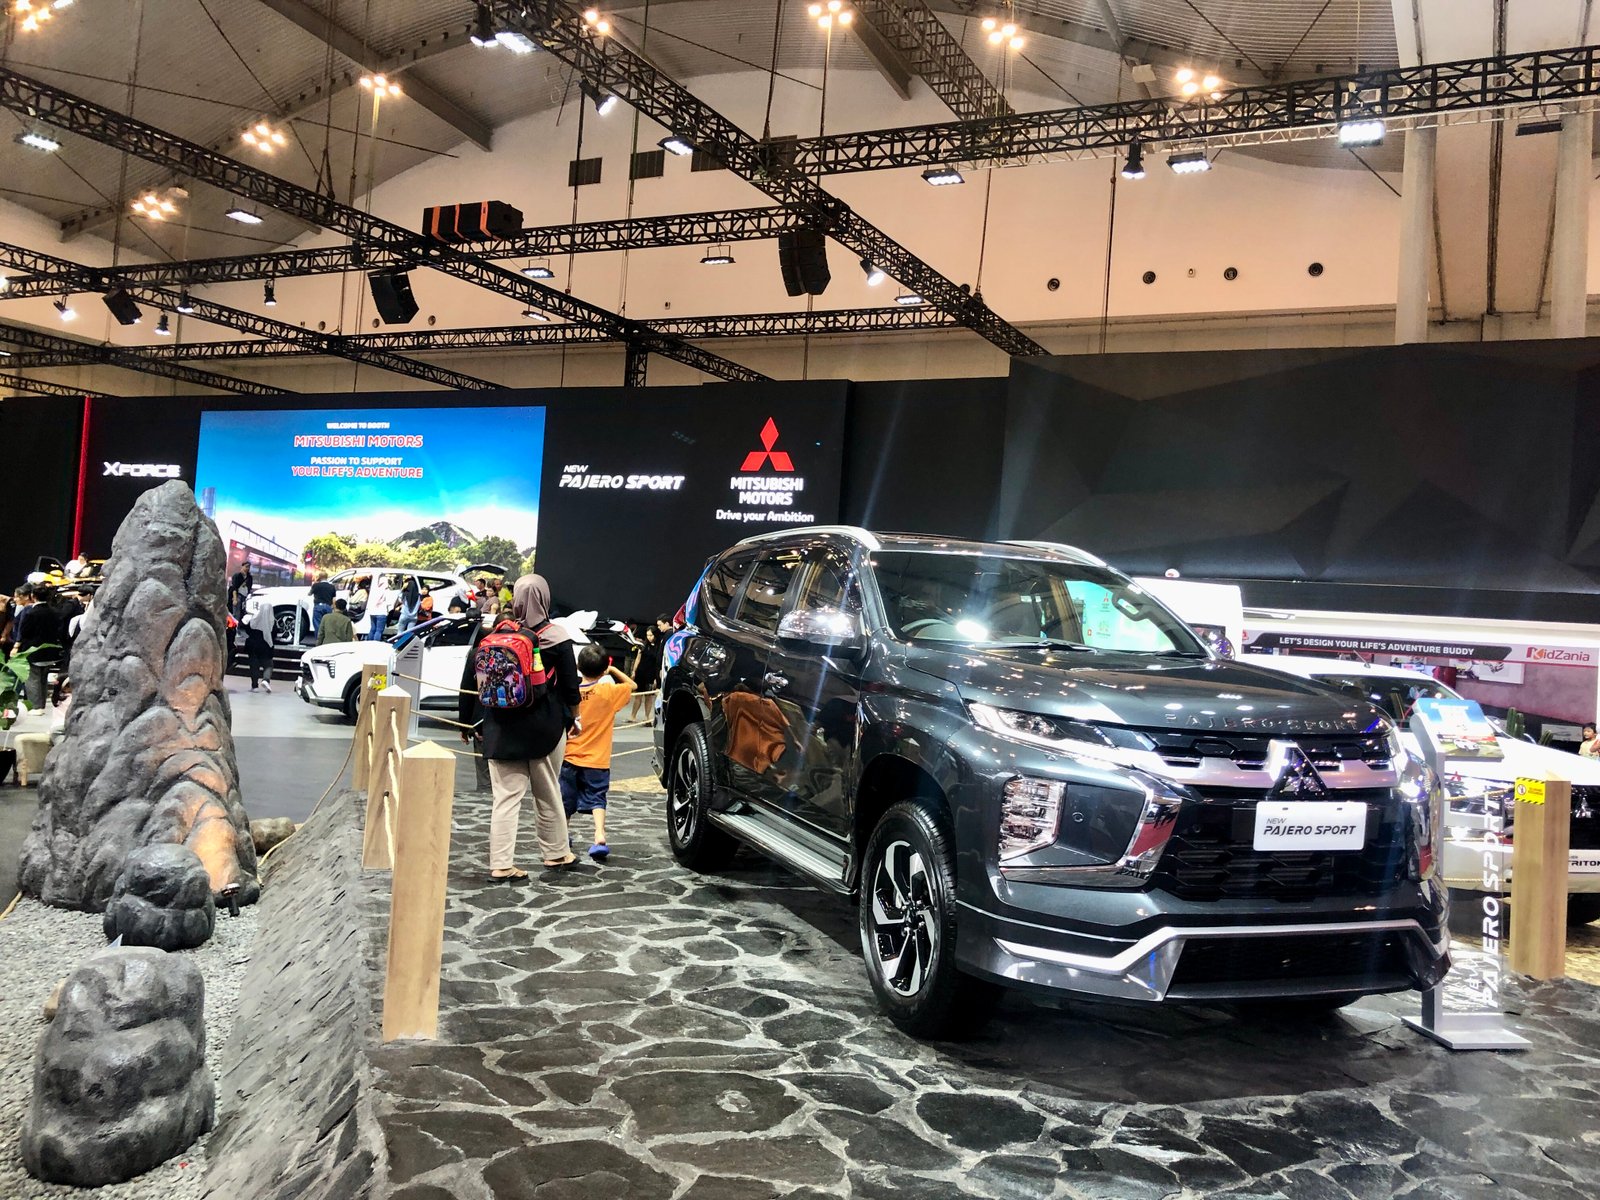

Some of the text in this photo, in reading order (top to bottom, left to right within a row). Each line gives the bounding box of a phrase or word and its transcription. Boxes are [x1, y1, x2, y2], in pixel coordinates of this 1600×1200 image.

[294, 435, 423, 447] MITSUBISHI MOTORS
[310, 457, 403, 465] PASSION TO SUPPORT
[102, 461, 181, 477] XFORCE
[291, 466, 423, 478] YOUR LIFE'S ADVENTURE
[563, 465, 589, 473] NEW
[558, 474, 685, 490] PAJERO SPORT
[730, 477, 804, 491] MITSUBISHI
[738, 491, 793, 505] MOTORS
[715, 509, 815, 522] Drive your Ambition
[1279, 637, 1475, 655] LET'S DESIGN YOUR LIFE'S ADVENTURE BUDDY
[1526, 646, 1590, 662] KidZania
[1266, 817, 1287, 825] NEW
[1263, 825, 1356, 836] PAJERO SPORT
[1482, 792, 1501, 1008] PAJERO SPORT
